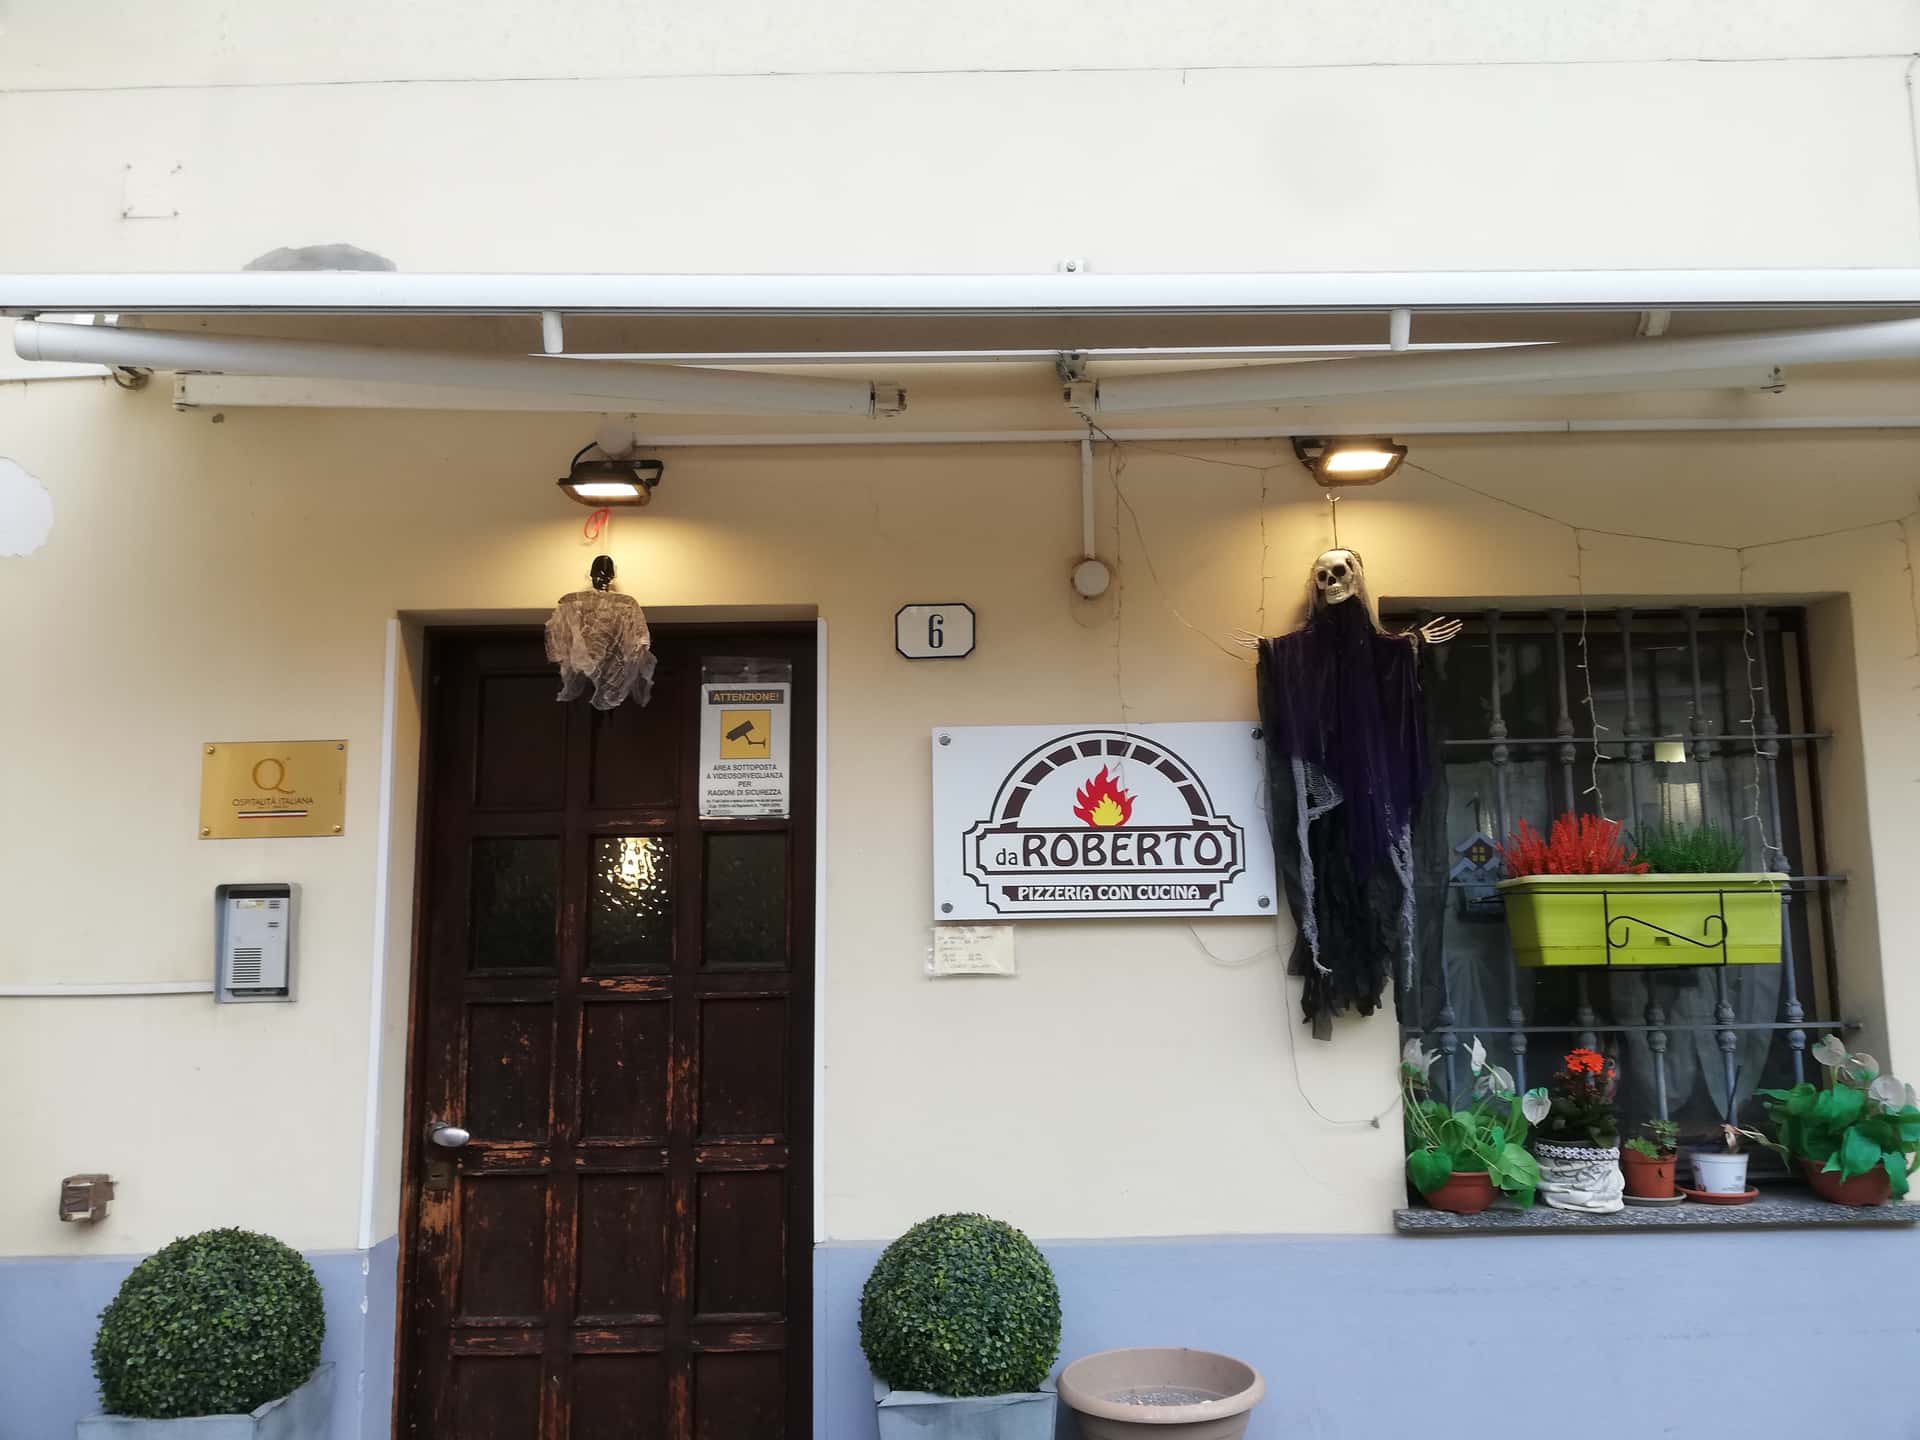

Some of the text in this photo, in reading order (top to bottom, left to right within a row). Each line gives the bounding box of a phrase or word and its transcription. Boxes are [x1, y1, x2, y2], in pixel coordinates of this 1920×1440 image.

[928, 614, 944, 649] 6
[712, 692, 780, 702] ATTENZIONE!
[732, 763, 777, 771] SOTTOPOSTA
[252, 758, 296, 794] Q
[713, 772, 784, 780] VIDEOSORVEGLIANZA
[707, 789, 735, 797] RAGIONI
[745, 788, 782, 796] SICUREZZA
[995, 831, 1224, 867] da ROBERTO
[1017, 884, 1202, 901] PIZZERIA CON CUCINA
